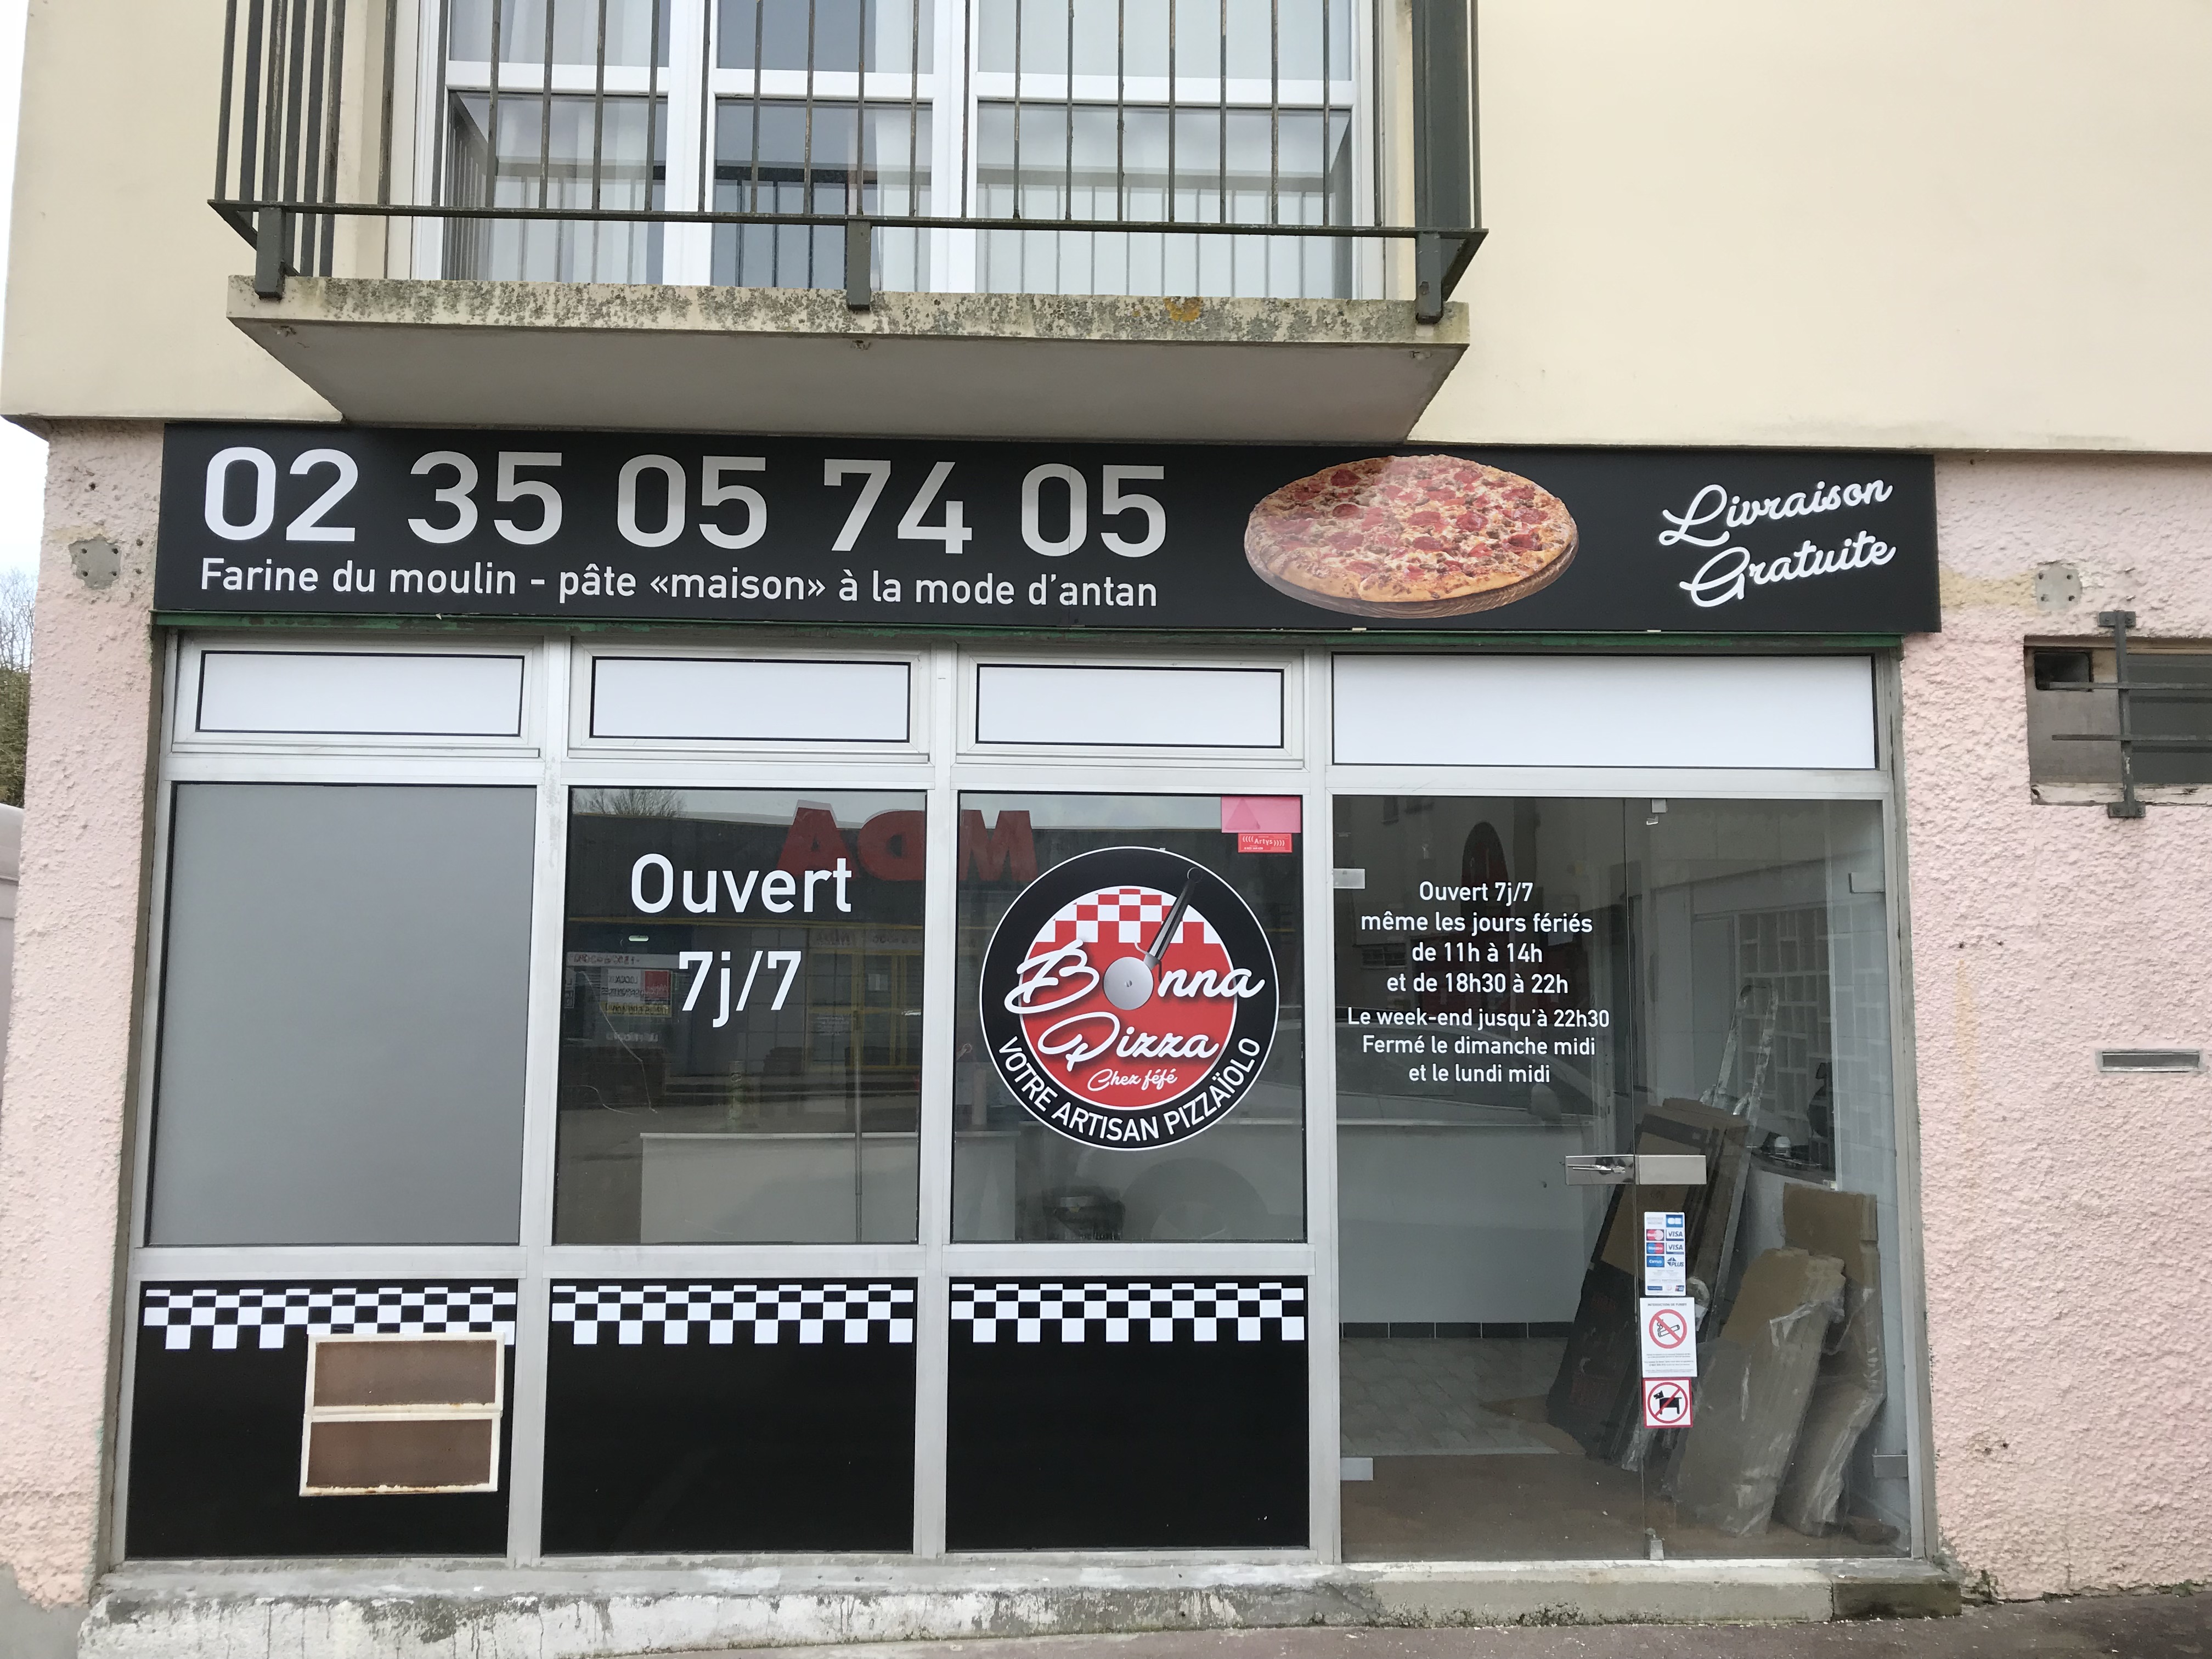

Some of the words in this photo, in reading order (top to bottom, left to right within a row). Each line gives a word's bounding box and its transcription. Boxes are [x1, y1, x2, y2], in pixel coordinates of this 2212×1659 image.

[204, 447, 359, 541] 02
[407, 450, 563, 545] 35
[617, 454, 768, 549] 05
[823, 459, 973, 554] 74
[1021, 463, 1167, 558] 05
[1658, 479, 1893, 548] Livraison
[201, 557, 319, 591] Farine
[332, 560, 376, 592] du
[390, 562, 516, 594] moulin
[559, 563, 636, 603] pâte
[650, 567, 826, 600] «maison»
[839, 569, 858, 601] à
[872, 570, 901, 602] la
[916, 572, 1014, 605] mode
[1679, 531, 1897, 607] Gratuite
[631, 853, 852, 913] Ouvert
[1419, 881, 1488, 901] Ouvert
[1495, 882, 1534, 906] 7j/7
[1361, 911, 1428, 931] même
[1435, 911, 1465, 932] les
[1471, 912, 1526, 936] jours
[1533, 912, 1593, 933] fériés
[1412, 941, 1436, 961] de
[1444, 942, 1480, 962] 11h
[1487, 942, 1498, 962] à
[1507, 943, 1543, 963] 14h
[679, 950, 802, 1028] 7j/7
[1387, 973, 1406, 991] et
[1413, 972, 1437, 992] de
[1446, 973, 1506, 993] 18h30
[1513, 973, 1524, 993] à
[1531, 973, 1568, 994] 22h
[1347, 1007, 1371, 1025] Le
[1376, 1007, 1472, 1026] week-end
[1554, 1009, 1610, 1028] 22h30
[1037, 1011, 1220, 1072] Pizza
[1363, 1035, 1425, 1053] Fermé
[1431, 1035, 1448, 1053] le
[1454, 1036, 1548, 1055] dimanche
[1554, 1037, 1595, 1055] midi
[998, 1036, 1058, 1111] VOTRE
[1051, 1102, 1160, 1142] ARTISAN
[1163, 1037, 1261, 1135] PIZZAÏOLO
[1087, 1068, 1141, 1091] Chez
[1141, 1067, 1178, 1091] féfé
[1408, 1064, 1426, 1081] et
[1432, 1063, 1449, 1082] le
[1455, 1063, 1502, 1082] lundi
[1509, 1064, 1550, 1082] midi
